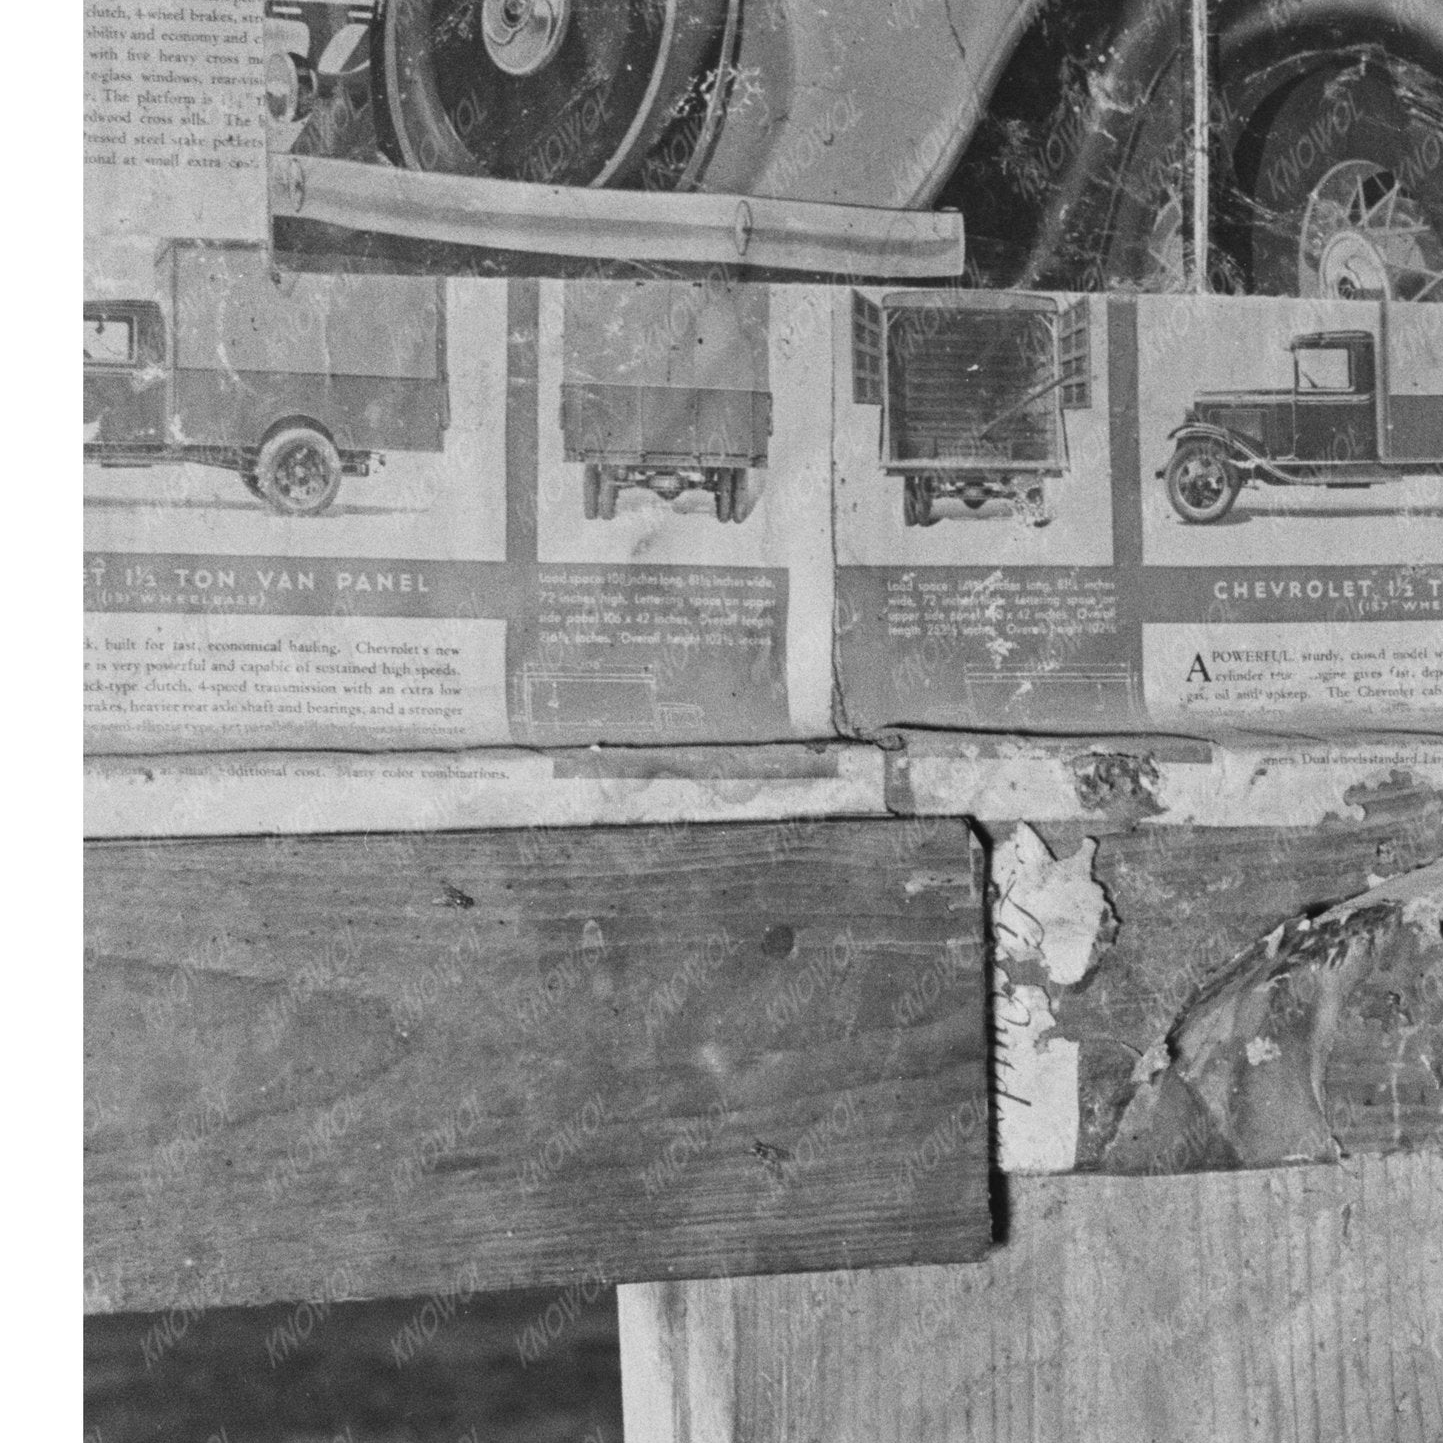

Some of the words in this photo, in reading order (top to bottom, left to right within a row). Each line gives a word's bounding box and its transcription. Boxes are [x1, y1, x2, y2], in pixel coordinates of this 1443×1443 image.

[174, 568, 235, 590] TON
[257, 570, 315, 591] VAN
[337, 572, 429, 593] PANEL
[1213, 579, 1372, 600] CHEVROLET
[105, 638, 136, 652] built
[145, 638, 165, 653] for
[208, 639, 282, 653] economical
[436, 645, 461, 656] new
[210, 659, 235, 673] and
[316, 661, 377, 676] sustained
[382, 661, 411, 678] high
[1186, 651, 1212, 683] A
